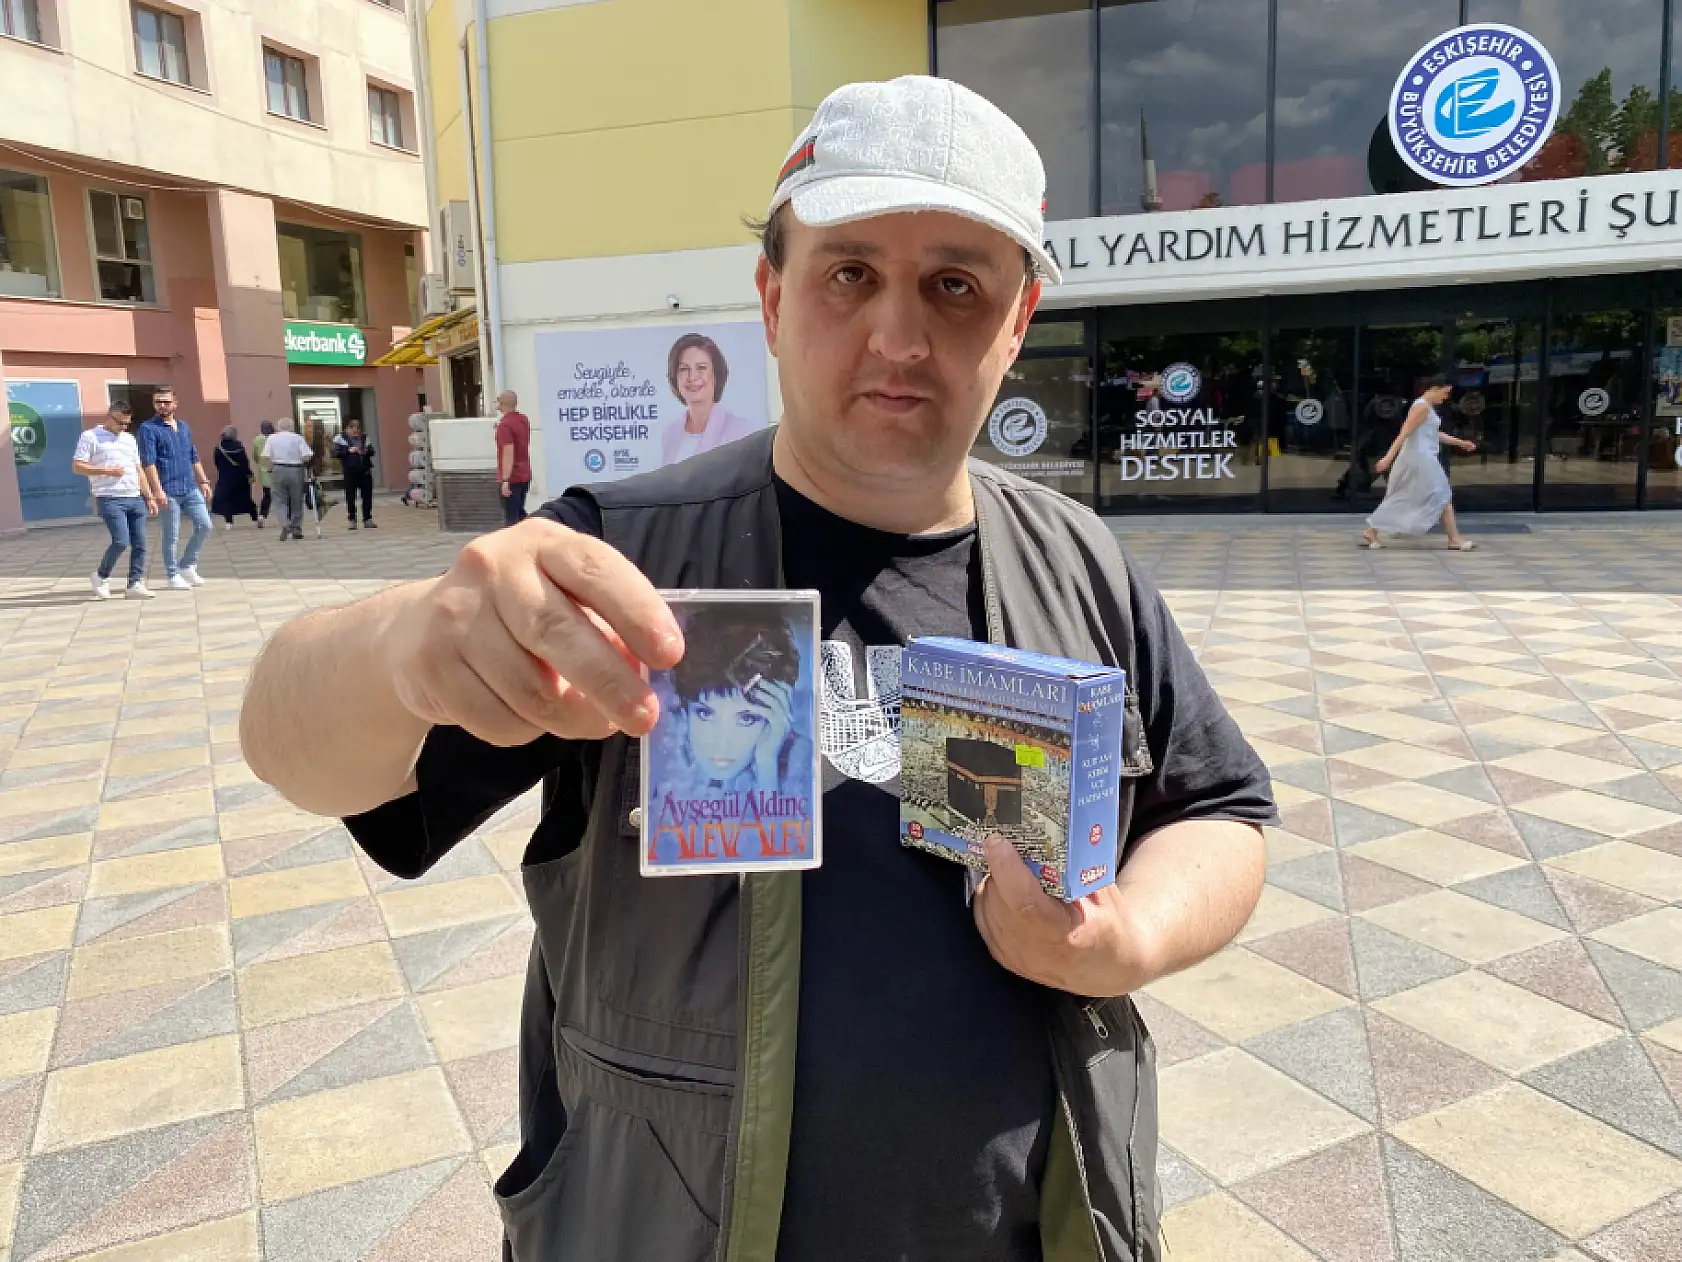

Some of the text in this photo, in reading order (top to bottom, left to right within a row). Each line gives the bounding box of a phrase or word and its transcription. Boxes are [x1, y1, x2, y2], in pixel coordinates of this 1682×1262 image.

[1422, 36, 1523, 74] ESKİŞEHİR
[1401, 72, 1548, 174] BÜYÜKŞEHİR BELEDİYESİ
[1098, 223, 1267, 267] YARDIM
[1283, 188, 1587, 254] HİZMETLERİ
[1608, 189, 1680, 238] ŞU
[559, 402, 658, 422] HEP BİRLİKLE
[1134, 407, 1219, 428] SOSYAL
[570, 421, 648, 443] ESKİŞEHİR
[1120, 429, 1238, 450] HİZMETLER
[1120, 453, 1236, 480] DESTEK
[907, 657, 954, 682] KABE
[959, 664, 1067, 704] İMAMLARI
